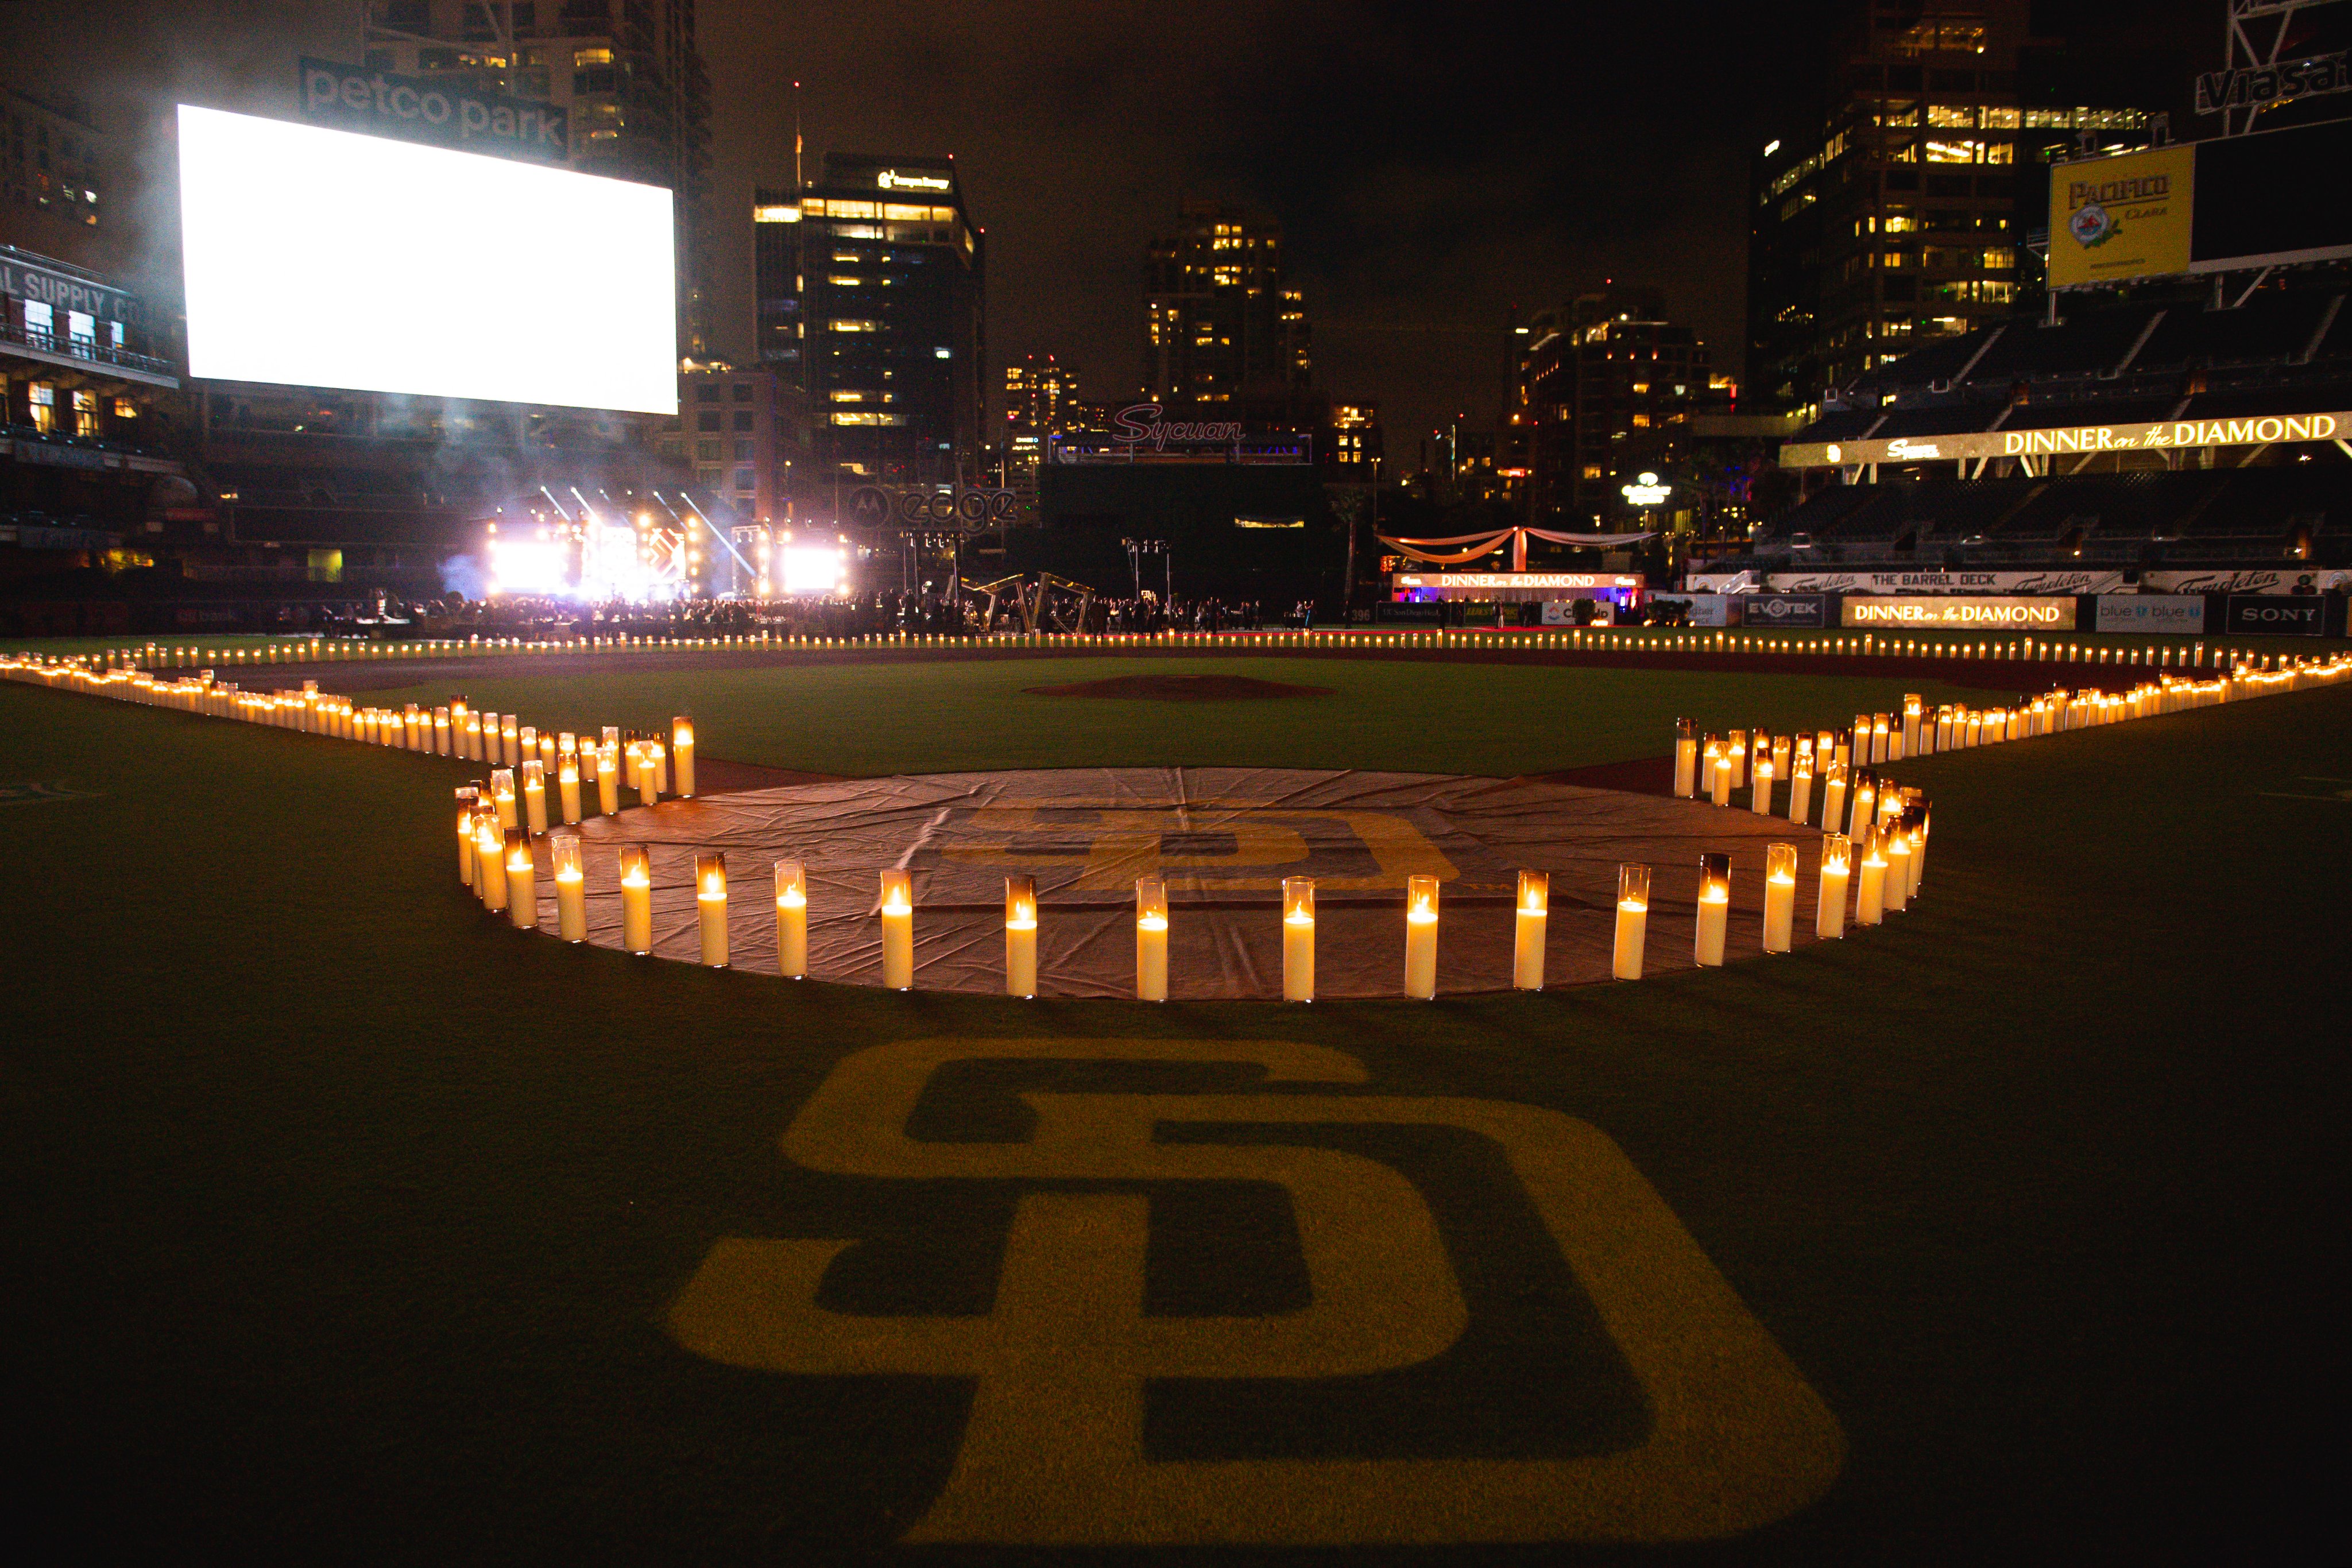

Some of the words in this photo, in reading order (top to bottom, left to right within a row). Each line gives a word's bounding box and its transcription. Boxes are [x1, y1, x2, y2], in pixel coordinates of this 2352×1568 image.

[305, 69, 452, 125] petco
[459, 97, 564, 147] park
[24, 272, 106, 318] SUPPLY
[1112, 402, 1247, 452] Sycuan
[2004, 424, 2113, 455] DINNER
[2113, 436, 2139, 448] on
[2142, 424, 2174, 447] the
[2173, 415, 2336, 446] DIAMOND
[902, 482, 1017, 537] edge
[1441, 575, 1495, 586] DINNER
[1523, 575, 1595, 586] DIAMOND
[1872, 574, 1897, 585] THE
[1902, 574, 1955, 585] BARREL
[1960, 574, 1996, 585] DECK
[1351, 608, 1371, 622] 396
[1854, 605, 1924, 621] DINNER
[1960, 606, 2060, 623] DIAMOND
[2100, 605, 2132, 617] blue
[2152, 605, 2185, 618] blue
[2241, 607, 2316, 622] SONY
